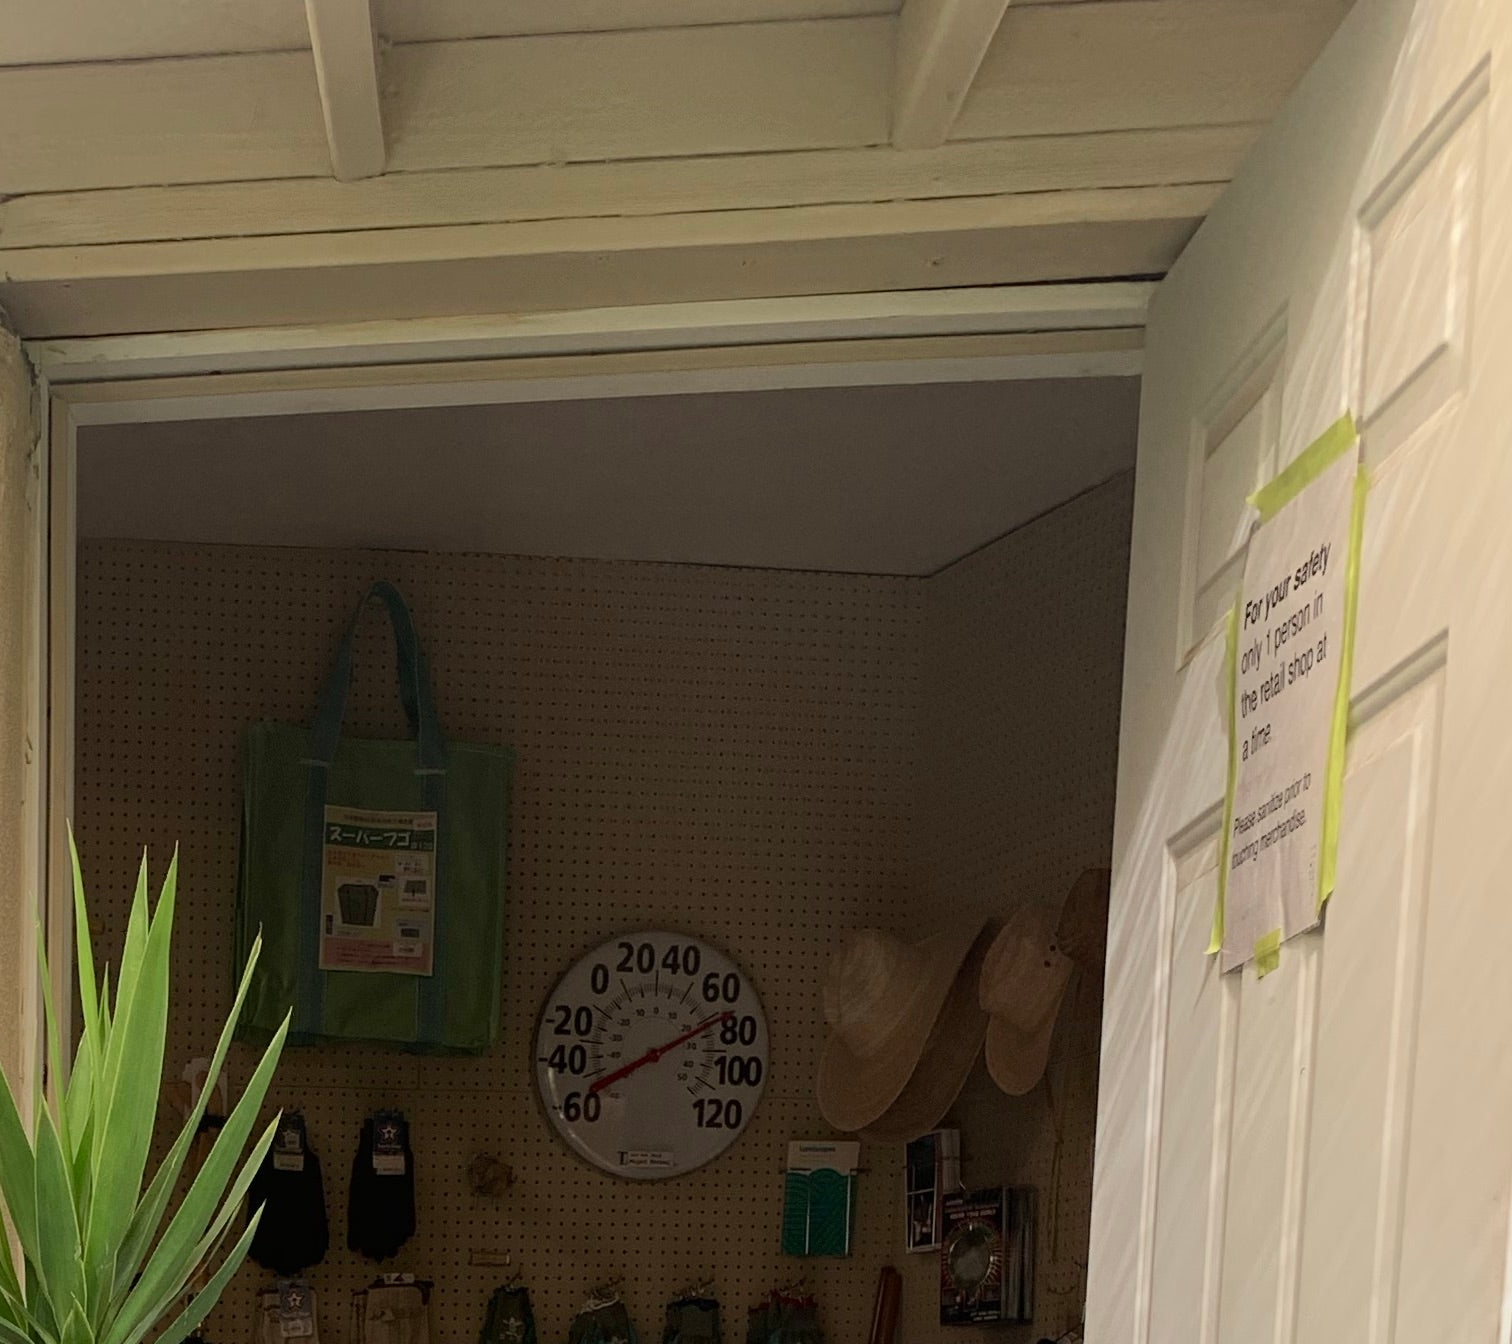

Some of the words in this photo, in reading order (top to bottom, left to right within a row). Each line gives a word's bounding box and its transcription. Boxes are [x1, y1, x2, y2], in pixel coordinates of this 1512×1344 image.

[1244, 597, 1263, 630] For
[1264, 575, 1291, 622] your
[1293, 542, 1331, 590] safety
[1241, 638, 1263, 674] only
[1274, 603, 1310, 657] person
[1312, 590, 1323, 620] in
[1241, 687, 1258, 718] the
[1260, 661, 1285, 704] retail
[1288, 646, 1314, 685] shop
[1316, 632, 1327, 663] at
[1233, 810, 1256, 838] Please
[616, 942, 655, 974] 20
[661, 945, 701, 976] 40
[591, 963, 609, 994] 0
[702, 972, 740, 1003] 60
[720, 1015, 757, 1046] 80
[714, 1055, 762, 1087] 100
[692, 1098, 742, 1129] 120
